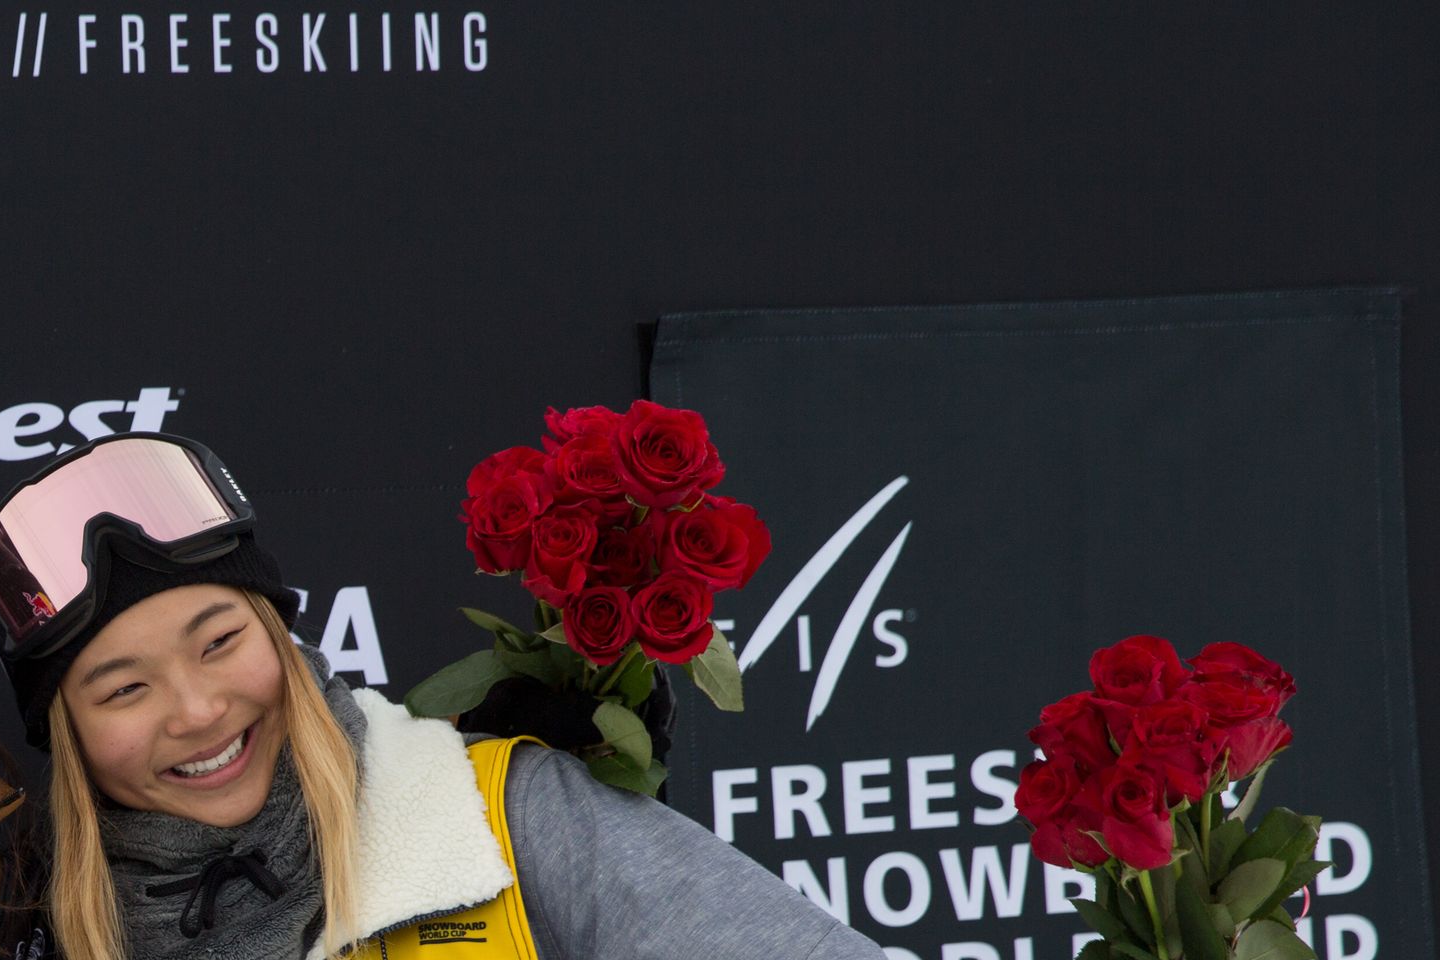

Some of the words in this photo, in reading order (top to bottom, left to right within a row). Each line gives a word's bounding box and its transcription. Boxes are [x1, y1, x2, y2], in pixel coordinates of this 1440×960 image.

[77, 11, 489, 75] FREESKIING
[418, 921, 488, 934] SNOWBOARD
[419, 930, 450, 940] WORLD
